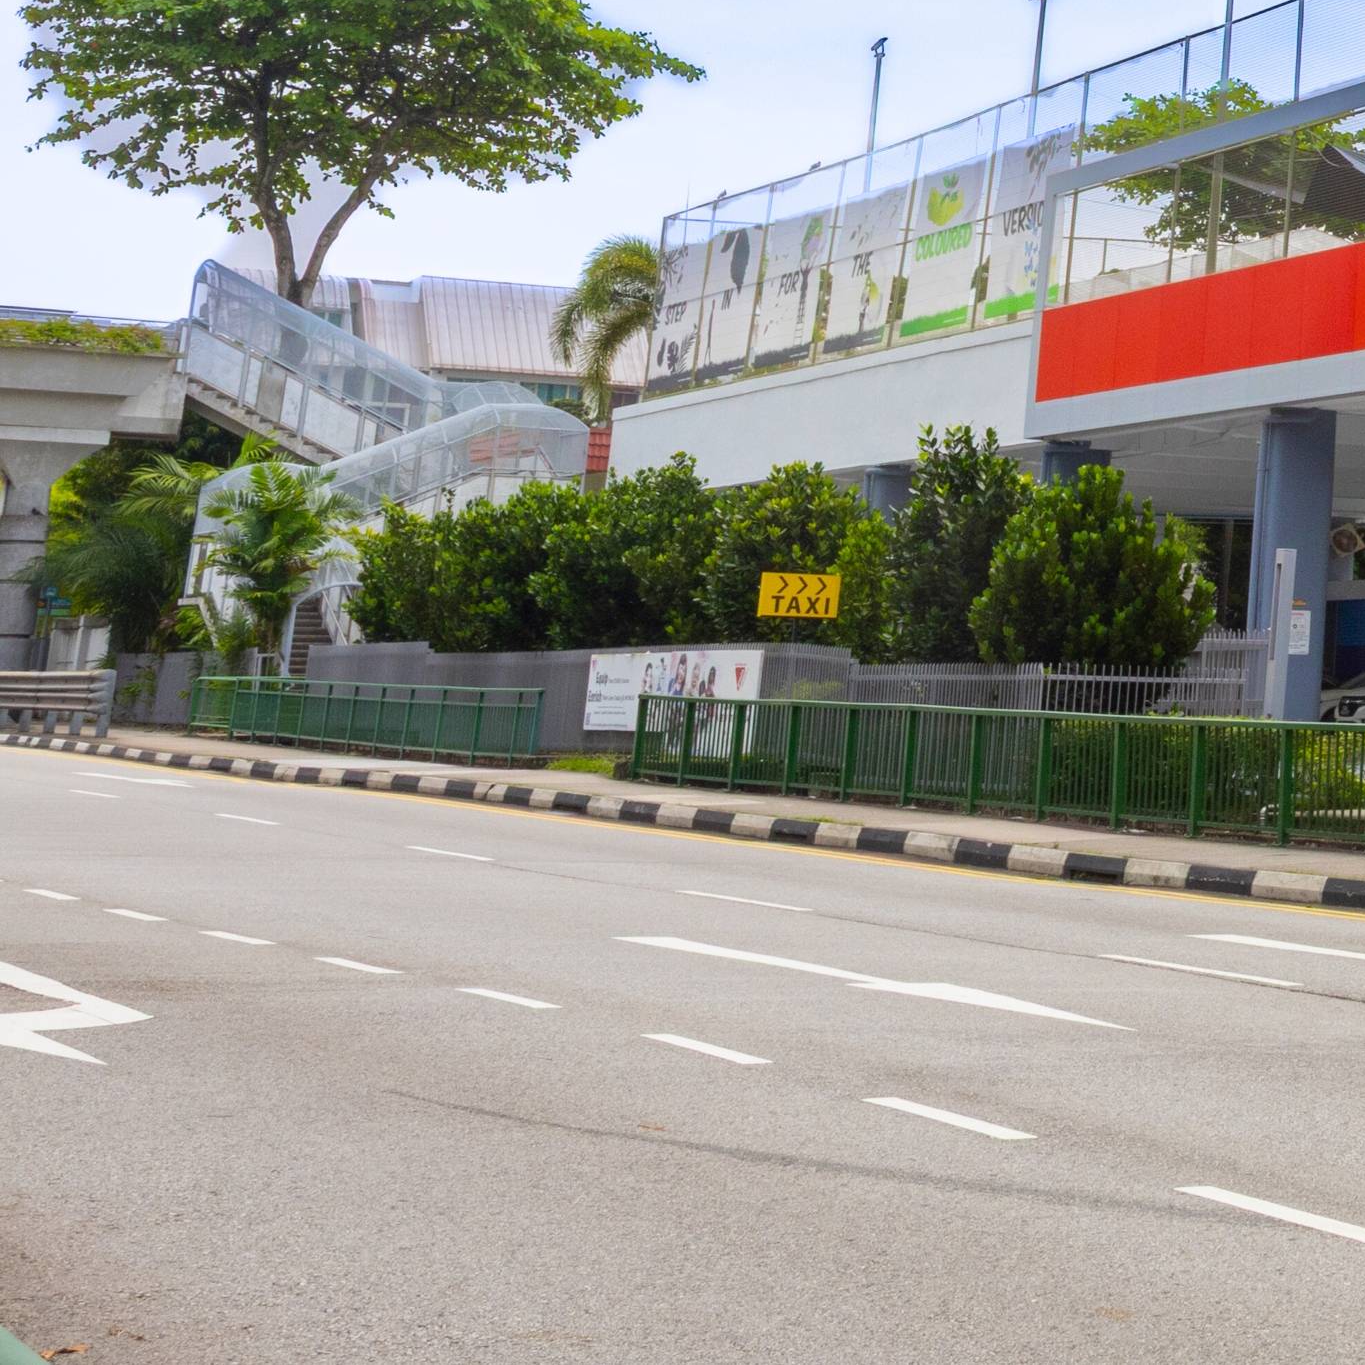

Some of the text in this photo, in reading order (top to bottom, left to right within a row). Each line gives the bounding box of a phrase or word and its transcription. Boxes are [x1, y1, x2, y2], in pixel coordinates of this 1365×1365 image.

[665, 301, 688, 326] STEP
[778, 270, 800, 296] FOR
[851, 250, 874, 278] THE
[1002, 200, 1046, 237] VERSIO
[770, 595, 831, 615] TAXI
